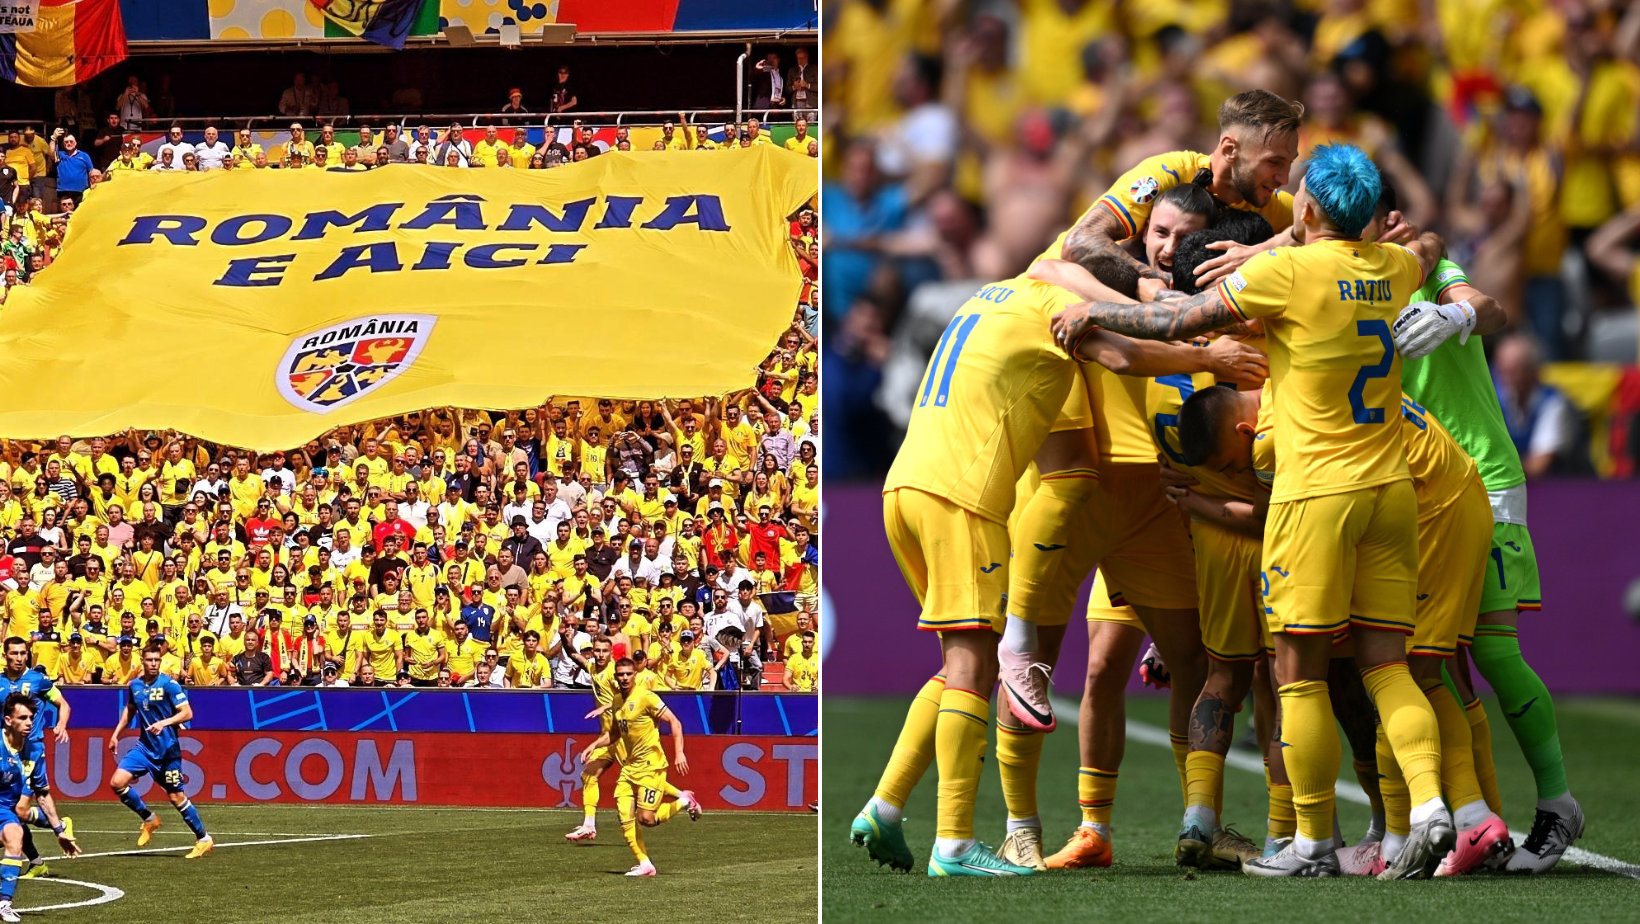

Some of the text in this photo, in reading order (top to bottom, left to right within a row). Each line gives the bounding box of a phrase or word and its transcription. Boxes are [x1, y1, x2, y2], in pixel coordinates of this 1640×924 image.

[11, 5, 30, 14] not
[116, 195, 732, 246] ROMÂNIA
[212, 241, 588, 287] E AICI
[1337, 280, 1392, 305] RAȚIU
[302, 318, 419, 350] ROMÂNIA
[919, 313, 982, 408] 11
[1347, 319, 1395, 424] 2
[1491, 547, 1507, 590] 1
[166, 594, 172, 603] 10
[477, 616, 486, 627] 14
[709, 617, 717, 626] 21
[801, 670, 811, 681] 24
[149, 687, 164, 701] 22
[164, 769, 181, 784] 22
[719, 742, 818, 807] ST
[643, 788, 656, 804] 18
